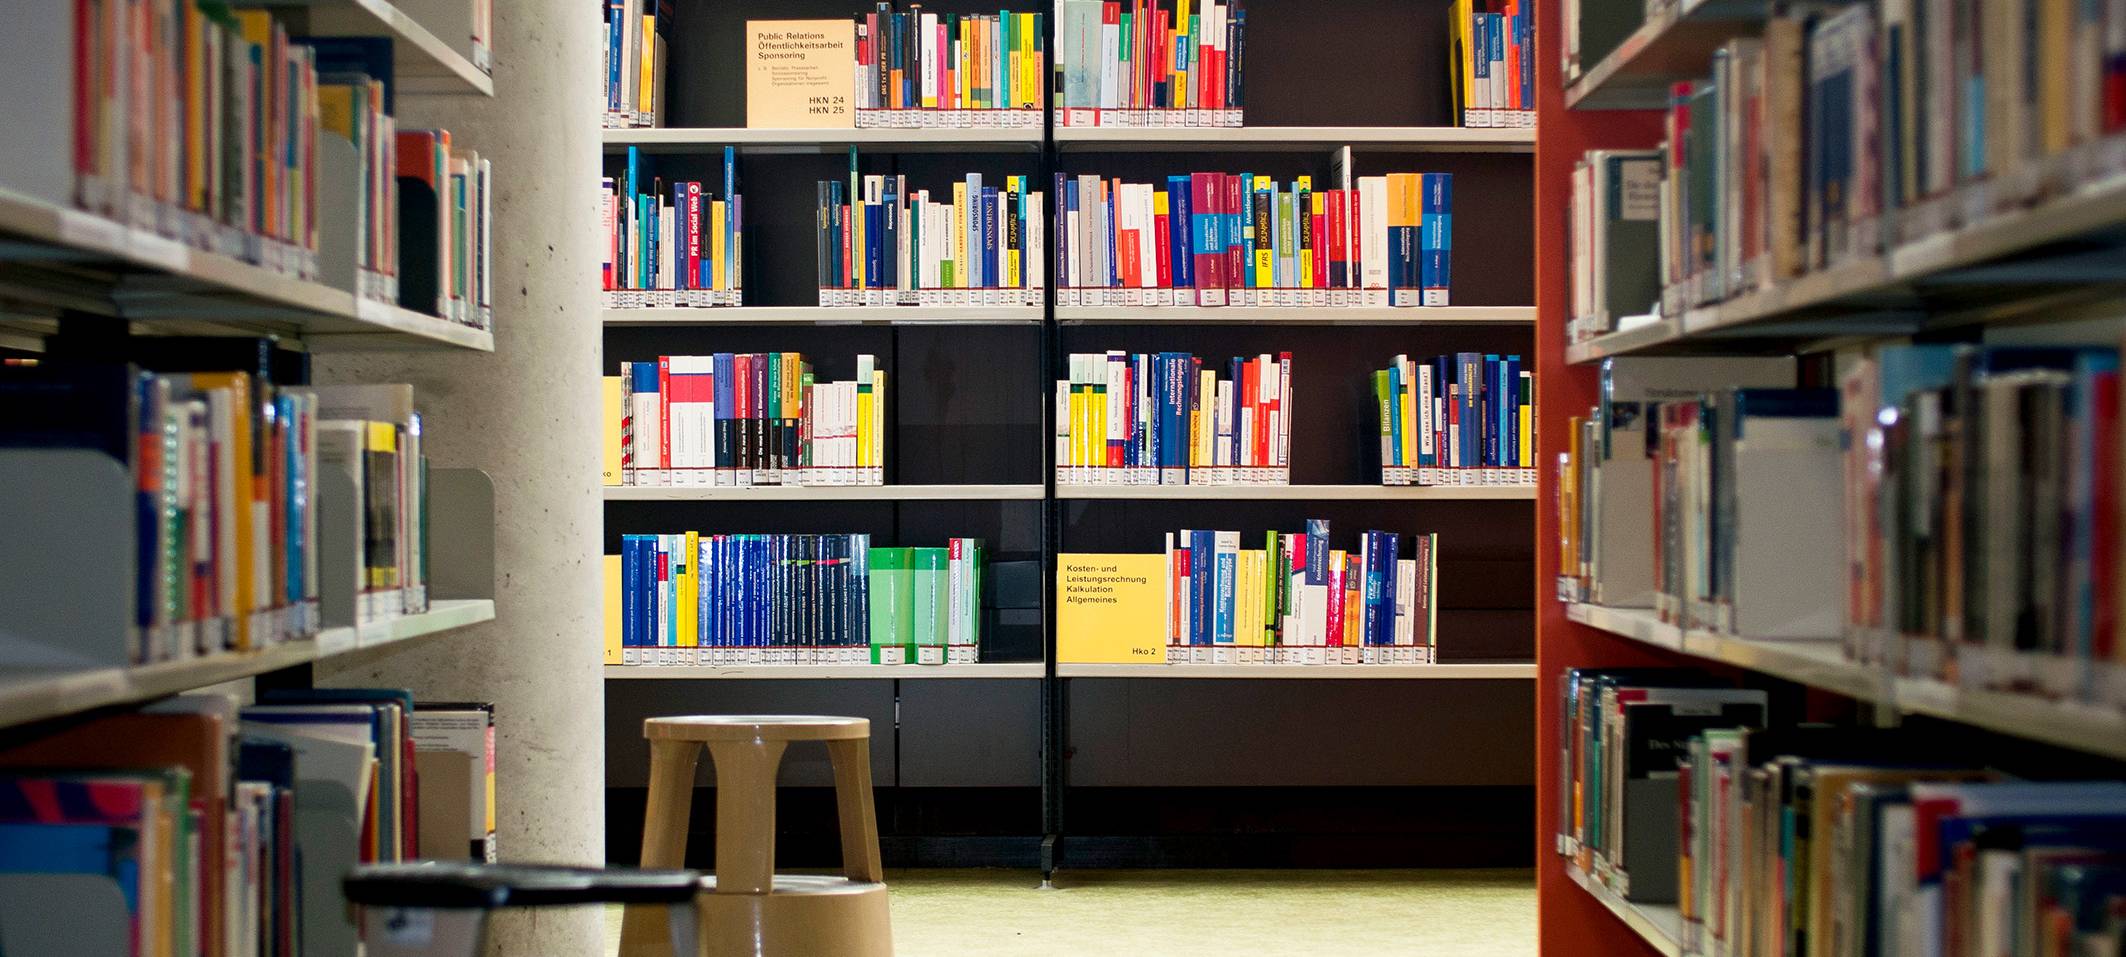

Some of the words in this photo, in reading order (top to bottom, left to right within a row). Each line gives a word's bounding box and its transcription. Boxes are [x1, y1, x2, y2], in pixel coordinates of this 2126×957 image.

[786, 32, 825, 40] Relations
[758, 41, 844, 50] Öffentlichkeitsarbeit
[758, 52, 806, 60] Sponsoring
[690, 236, 698, 245] im
[690, 247, 698, 256] PR
[1066, 576, 1147, 584] Leistungsrechnung
[1066, 596, 1118, 604] Allgemeines
